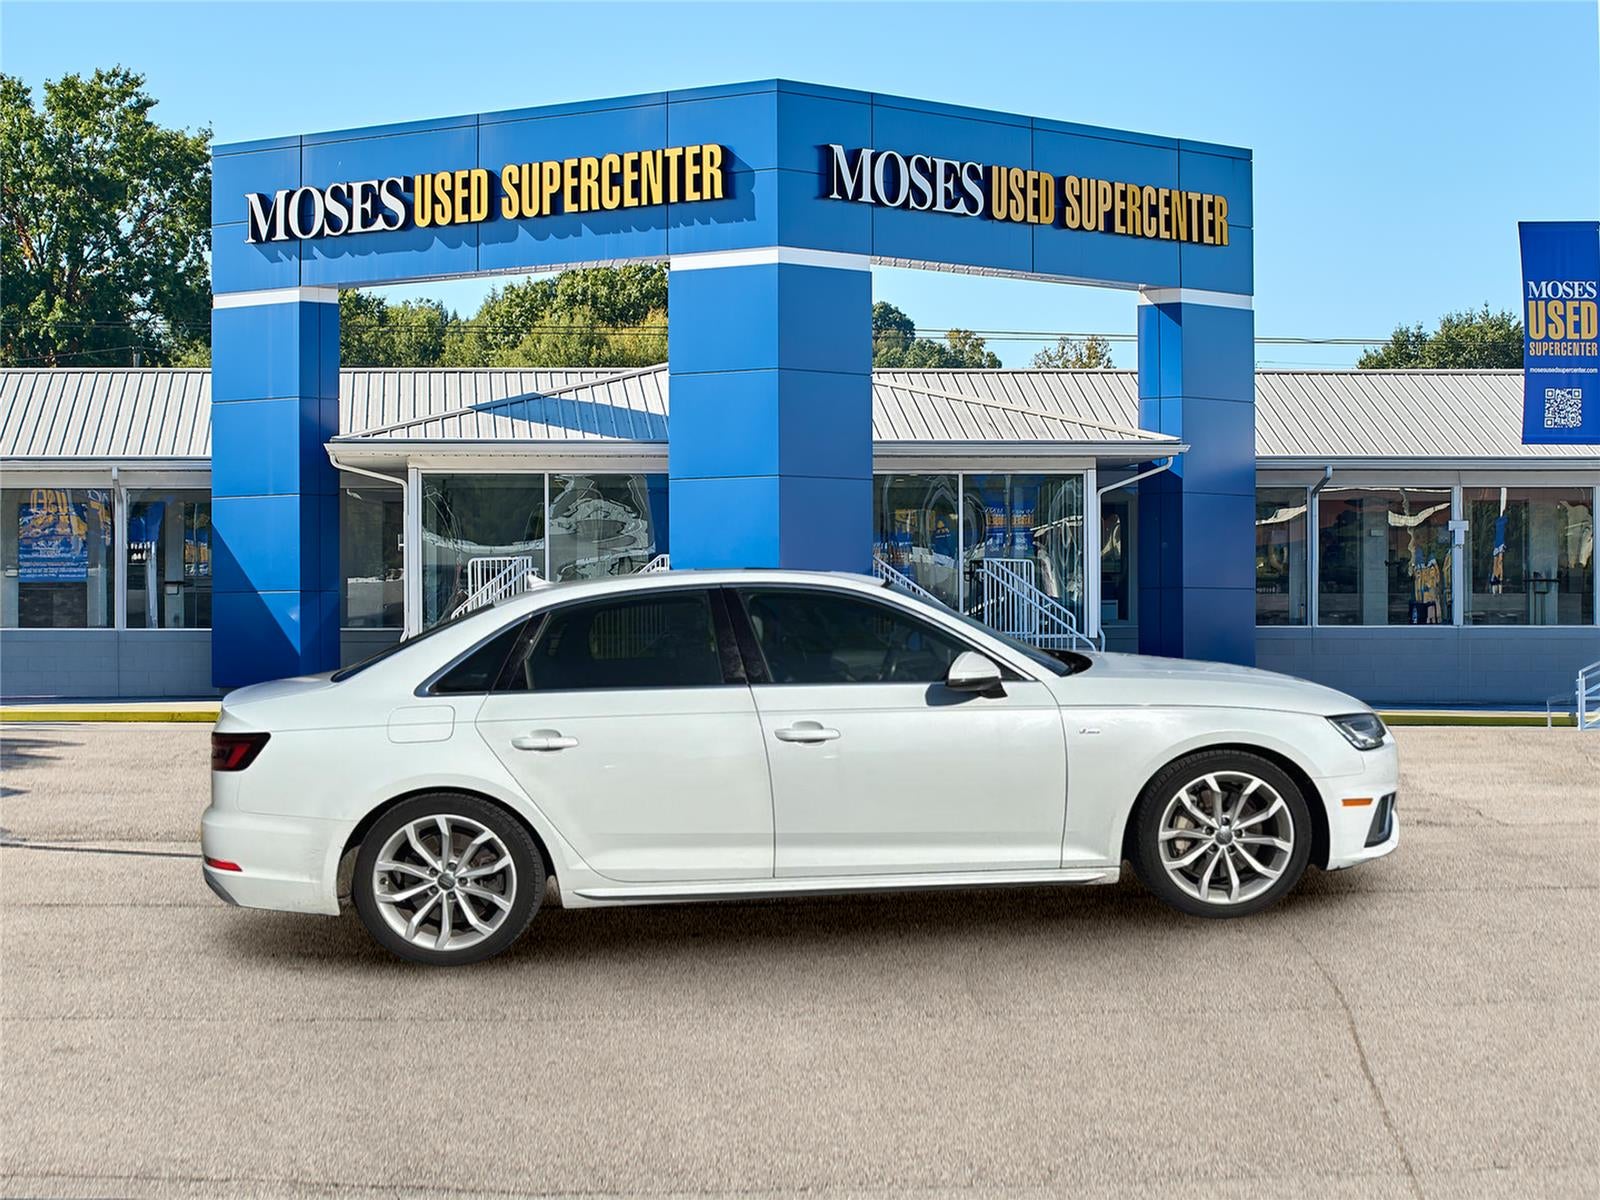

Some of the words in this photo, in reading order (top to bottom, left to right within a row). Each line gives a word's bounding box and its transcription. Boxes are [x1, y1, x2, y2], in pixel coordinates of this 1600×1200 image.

[244, 177, 407, 244] MOSES
[413, 168, 489, 229] USED
[500, 144, 724, 220] SUPERCENTER
[829, 143, 984, 217] MOSES
[991, 165, 1056, 224] USED
[1064, 175, 1230, 246] SUPERCENTER
[1528, 281, 1597, 299] MOSES
[1528, 300, 1598, 340] USED
[1529, 341, 1598, 356] SUPERCENTER
